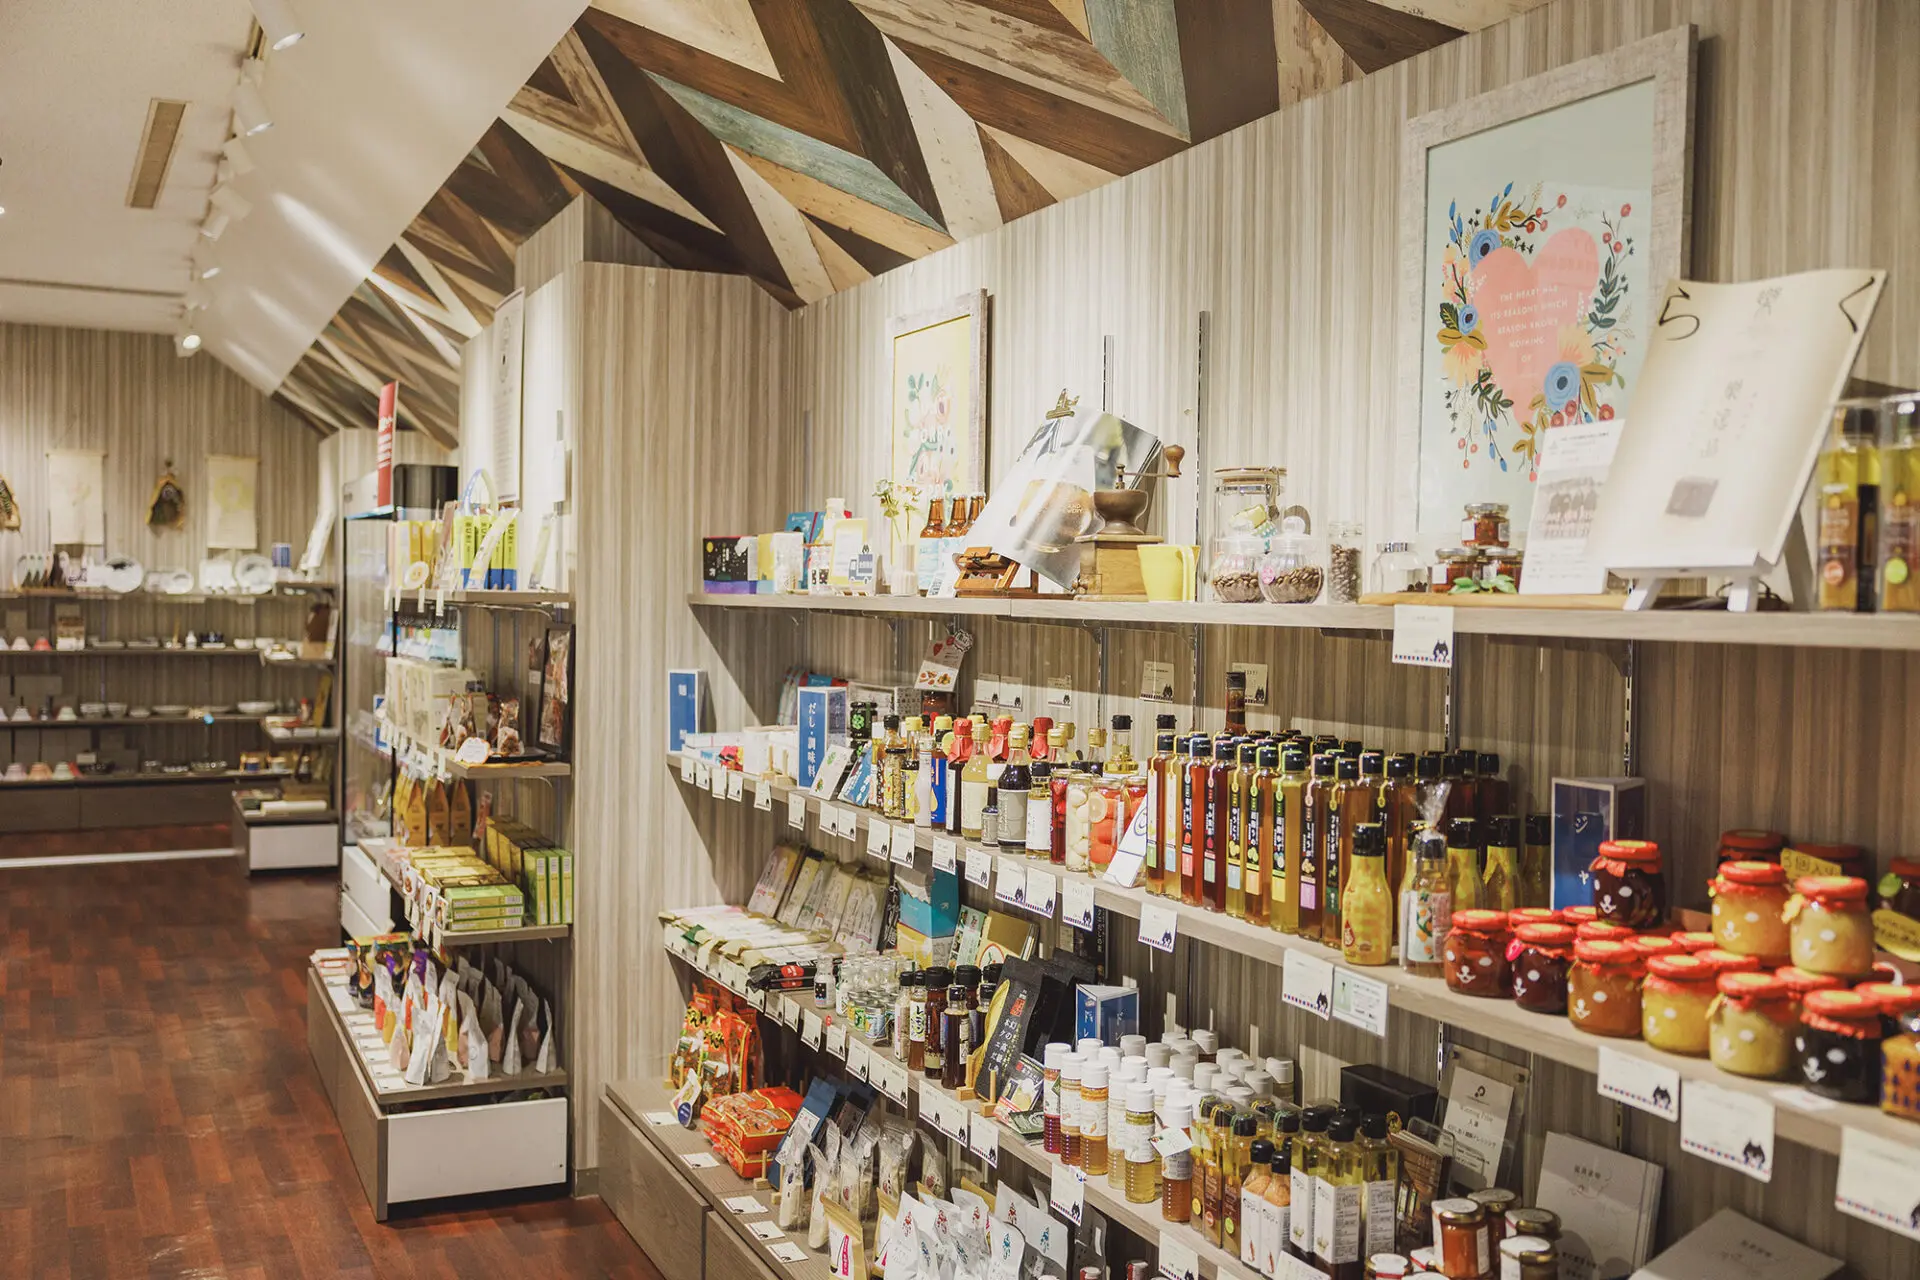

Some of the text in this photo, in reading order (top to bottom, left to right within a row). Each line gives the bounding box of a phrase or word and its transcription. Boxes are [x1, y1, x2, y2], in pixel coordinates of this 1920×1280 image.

[1500, 293, 1512, 302] THE
[1516, 288, 1539, 299] HEART
[1490, 312, 1501, 320] ITS
[1504, 304, 1540, 317] REASONS
[1498, 323, 1527, 335] REASON
[1509, 336, 1546, 348] NOTHING
